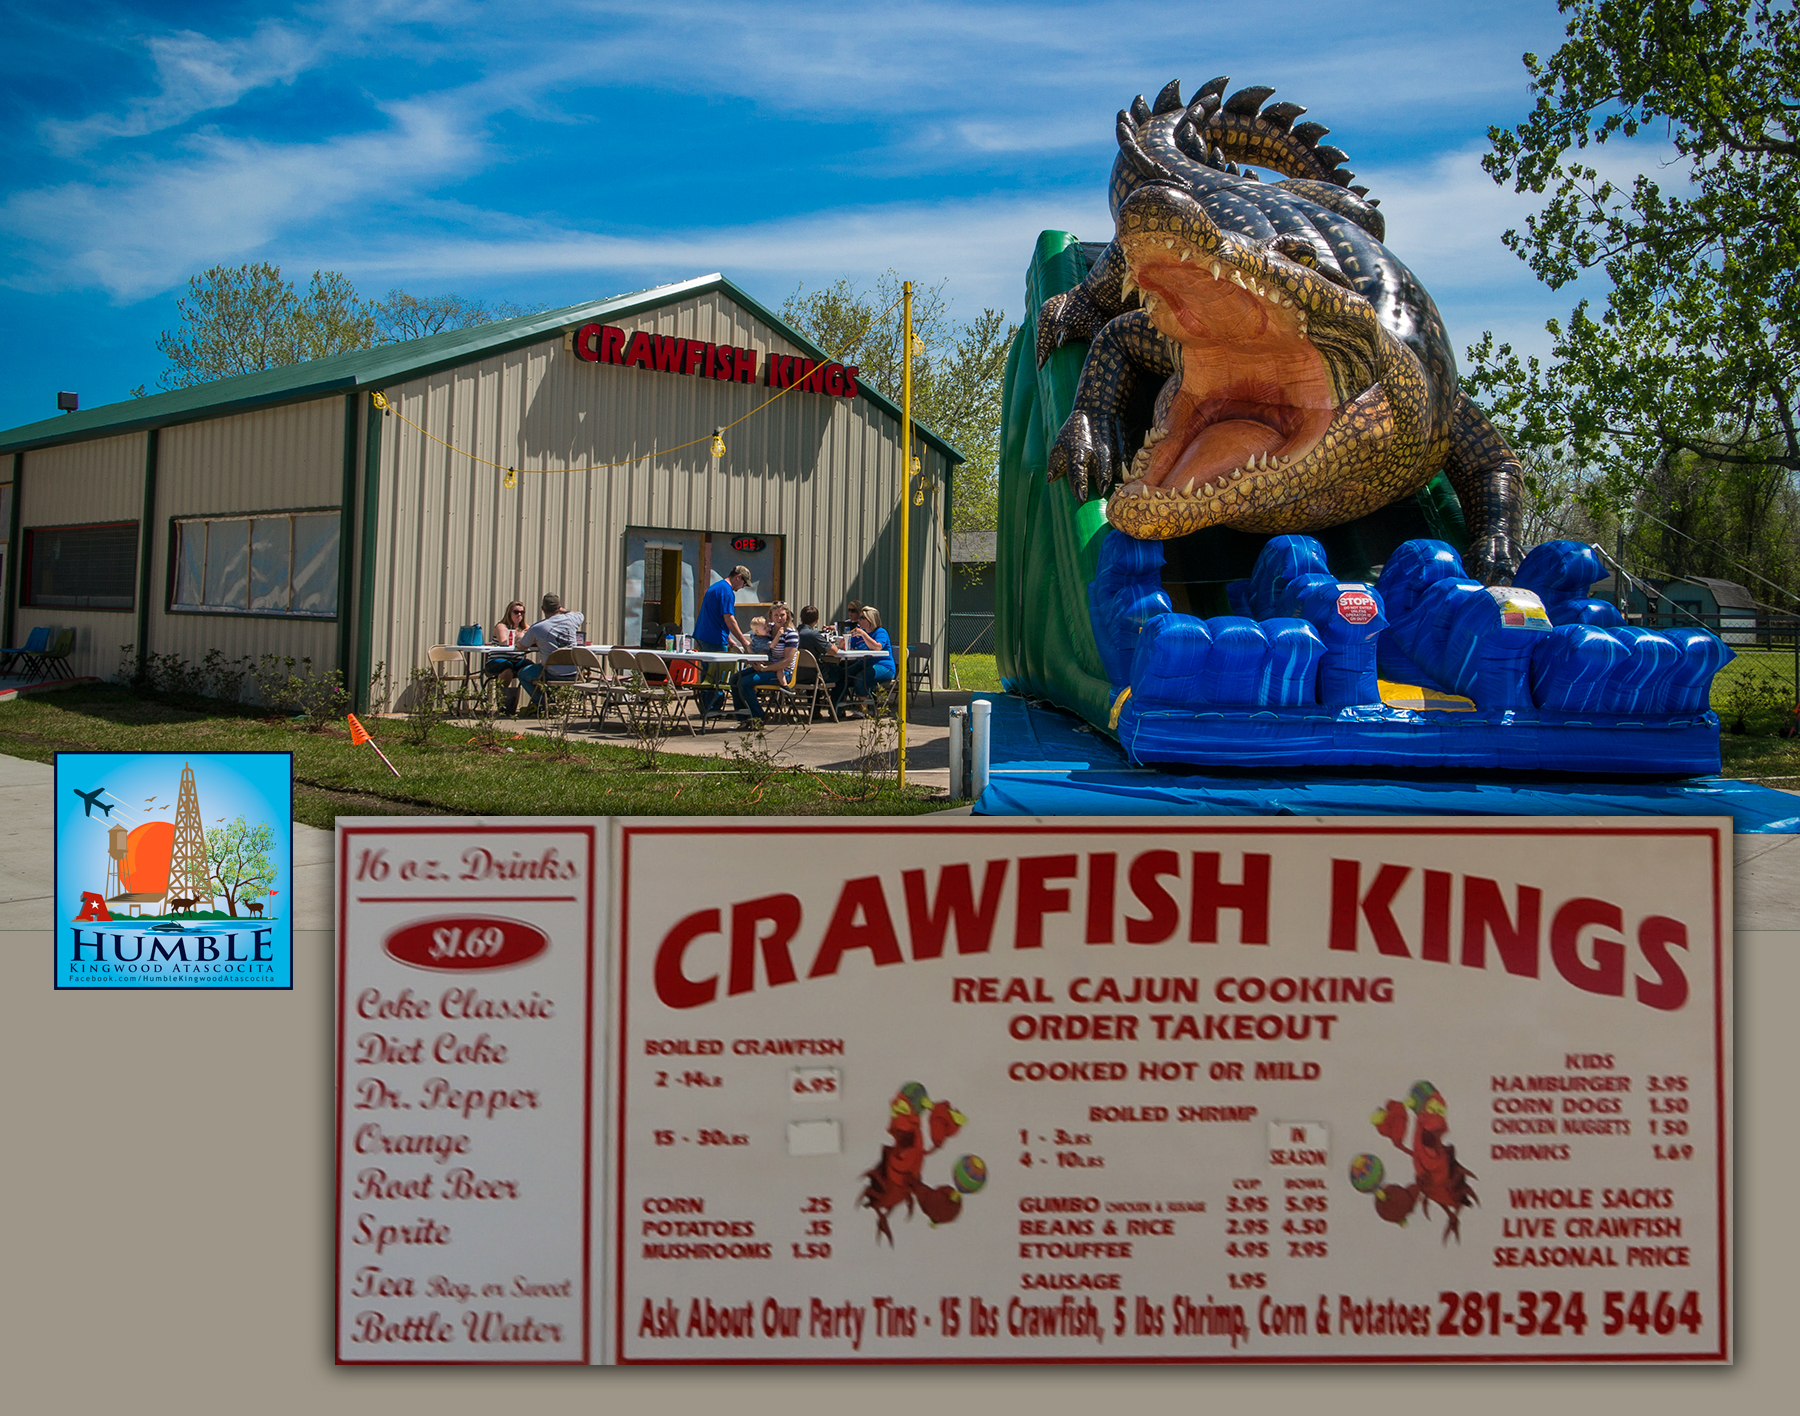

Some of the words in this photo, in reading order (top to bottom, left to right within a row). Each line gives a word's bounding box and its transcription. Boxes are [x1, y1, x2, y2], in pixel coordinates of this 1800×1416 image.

[573, 322, 757, 384] CRAWFISH
[765, 352, 859, 398] KINGS
[355, 849, 390, 881] 16
[399, 861, 449, 881] oz.
[459, 847, 577, 881] Drinks
[651, 849, 1273, 1010] CRAWFISH
[1329, 857, 1690, 1012] KINGS
[428, 926, 505, 962] $1.69
[951, 976, 1055, 1004] REAL
[1066, 976, 1201, 1005] CAJUN
[1212, 976, 1396, 1004] COOKING
[355, 988, 431, 1020] Coke
[438, 988, 554, 1020] Classic
[1007, 1013, 1139, 1041] ORDER
[1151, 1013, 1338, 1041] TAKEOUT
[355, 1033, 424, 1065] Diet
[432, 1033, 508, 1065] Coke
[643, 1038, 725, 1056] BOILED
[731, 1038, 845, 1057] CRAWFISH
[1007, 1061, 1129, 1082] COOKED
[1137, 1061, 1200, 1082] HOT
[1207, 1061, 1245, 1082] OR
[1253, 1061, 1322, 1082] MILD
[1564, 1053, 1616, 1071] KIDS
[1490, 1075, 1633, 1093] HAMBURGER
[354, 1078, 410, 1110] Dr.
[420, 1078, 541, 1118] Pepper
[1491, 1097, 1554, 1115] CORN
[1562, 1097, 1623, 1115] DOGS
[1088, 1105, 1169, 1123] BOILED
[1177, 1105, 1259, 1123] SHRIMP
[1491, 1117, 1557, 1136] CHICKEN
[1562, 1117, 1632, 1136] NUGGETS
[353, 1124, 470, 1163] Orange
[653, 1129, 675, 1146] 15
[1269, 1149, 1327, 1166] SEASON
[1490, 1143, 1571, 1162] DRINKS
[353, 1169, 433, 1201] Root
[441, 1168, 519, 1201] Beer
[1232, 1178, 1262, 1191] CUP
[1284, 1178, 1328, 1191] BOWL
[642, 1197, 704, 1215] CORN
[1018, 1196, 1100, 1215] GUMBO
[1508, 1188, 1594, 1210] WHOLE
[1601, 1188, 1674, 1210] SACKS
[352, 1213, 451, 1254] Sprite
[642, 1220, 755, 1238] POTATOES
[1018, 1219, 1095, 1237] BEANS
[1102, 1219, 1118, 1236] &
[1126, 1219, 1176, 1237] RICE
[1502, 1217, 1557, 1239] LIVE
[1563, 1217, 1683, 1239] CRAWFISH
[642, 1243, 773, 1260] MUSHROOMS
[1018, 1241, 1134, 1259] ETOUFFEE
[1493, 1246, 1619, 1268] SEASONAL
[1625, 1246, 1691, 1268] PRICE
[351, 1266, 416, 1298] Tea
[481, 1284, 504, 1298] or
[510, 1275, 572, 1298] Sweet
[1021, 1273, 1122, 1291] SAUSAGE
[351, 1311, 453, 1343] Bottle
[462, 1311, 563, 1343] Water
[638, 1299, 679, 1338] Ask
[686, 1298, 754, 1338] About
[761, 1297, 802, 1338] Our
[809, 1298, 866, 1351] Party
[871, 1297, 917, 1337] Tins
[939, 1297, 961, 1337] 15
[969, 1297, 999, 1337] lbs
[1006, 1296, 1105, 1344] Crawfish,
[1113, 1296, 1127, 1337] 5
[1134, 1296, 1166, 1337] lbs
[1172, 1295, 1250, 1349] Shrimp,
[1258, 1295, 1308, 1336] Corn
[1314, 1295, 1331, 1335] &
[1338, 1295, 1431, 1337] Potatoes
[1436, 1290, 1589, 1337] 281-324
[1602, 1290, 1704, 1335] 5464
